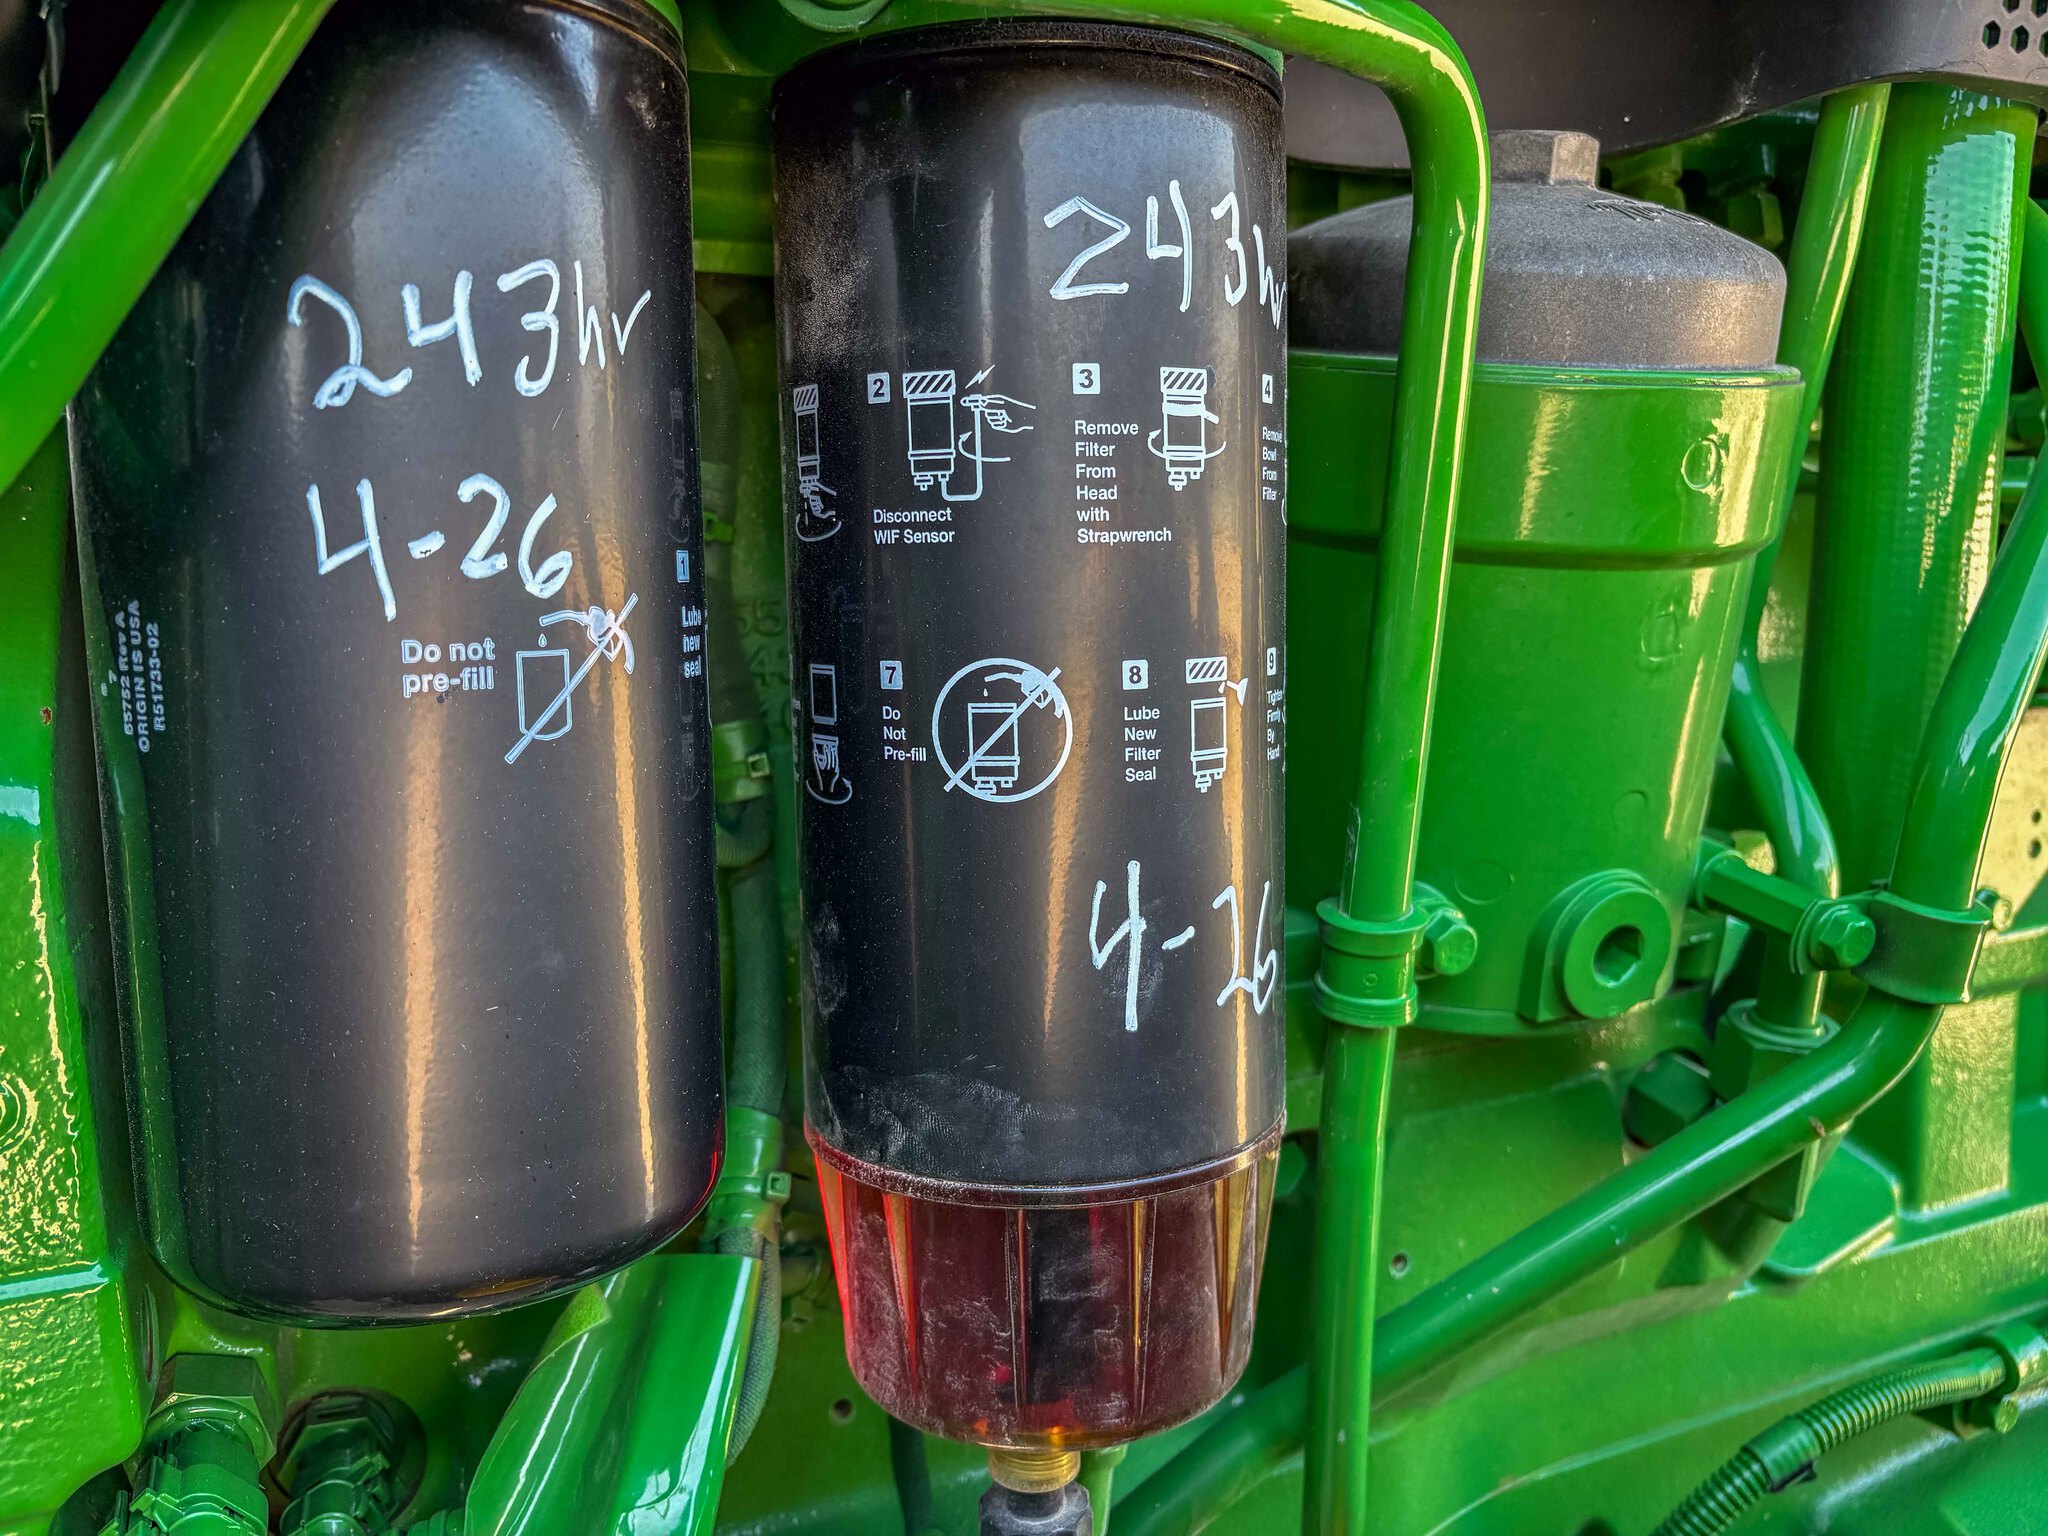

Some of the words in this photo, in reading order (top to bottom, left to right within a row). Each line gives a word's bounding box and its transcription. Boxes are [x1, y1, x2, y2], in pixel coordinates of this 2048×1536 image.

[871, 376, 887, 399] 2
[1077, 367, 1095, 390] 3
[1074, 420, 1140, 436] Remove
[1075, 442, 1115, 457] Filter
[1075, 463, 1116, 479] From
[1262, 466, 1277, 481] From
[1076, 485, 1118, 500] Head
[873, 507, 952, 524] Disconnect
[1077, 507, 1110, 522] with
[874, 529, 900, 545] WIF
[903, 528, 955, 544] Sensor
[1077, 527, 1172, 546] Strapwrench
[306, 472, 573, 622] 4-26
[114, 610, 126, 629] A
[127, 599, 142, 646] USA
[681, 606, 702, 628] Lube
[401, 639, 442, 664] Do
[449, 637, 496, 662] not
[683, 635, 701, 653] new
[132, 649, 145, 673] IS
[684, 656, 702, 679] seal
[146, 621, 167, 732] R51733-02
[402, 665, 495, 699] pre-fill
[883, 664, 899, 686] 7
[1127, 664, 1143, 686] 8
[133, 676, 151, 754] ORIGIN
[882, 706, 901, 720] Do
[1124, 706, 1160, 721] Lube
[883, 726, 906, 740] Not
[1124, 727, 1157, 741] New
[884, 746, 927, 761] Pre-fill
[1125, 747, 1161, 762] Filter
[1125, 767, 1157, 782] Seal
